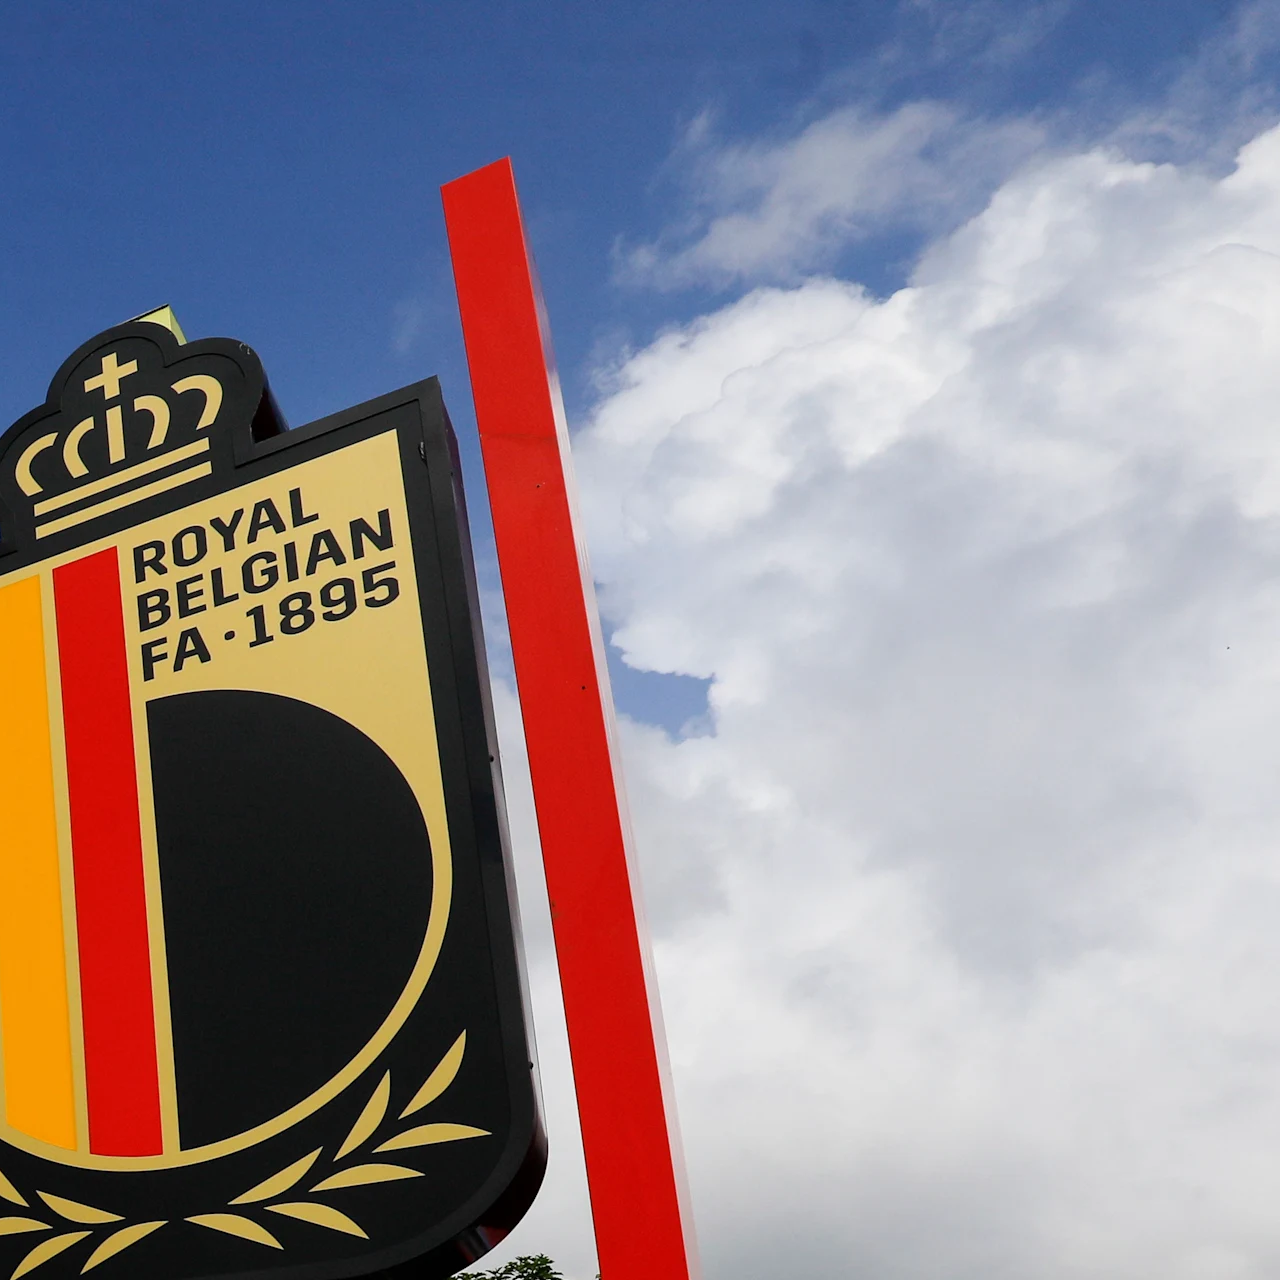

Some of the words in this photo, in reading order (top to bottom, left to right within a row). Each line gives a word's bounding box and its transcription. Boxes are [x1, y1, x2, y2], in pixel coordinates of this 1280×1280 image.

[132, 486, 320, 585] ROYAL
[136, 507, 395, 633] BELGIAN
[140, 626, 212, 682] FA
[245, 560, 400, 649] 1895
